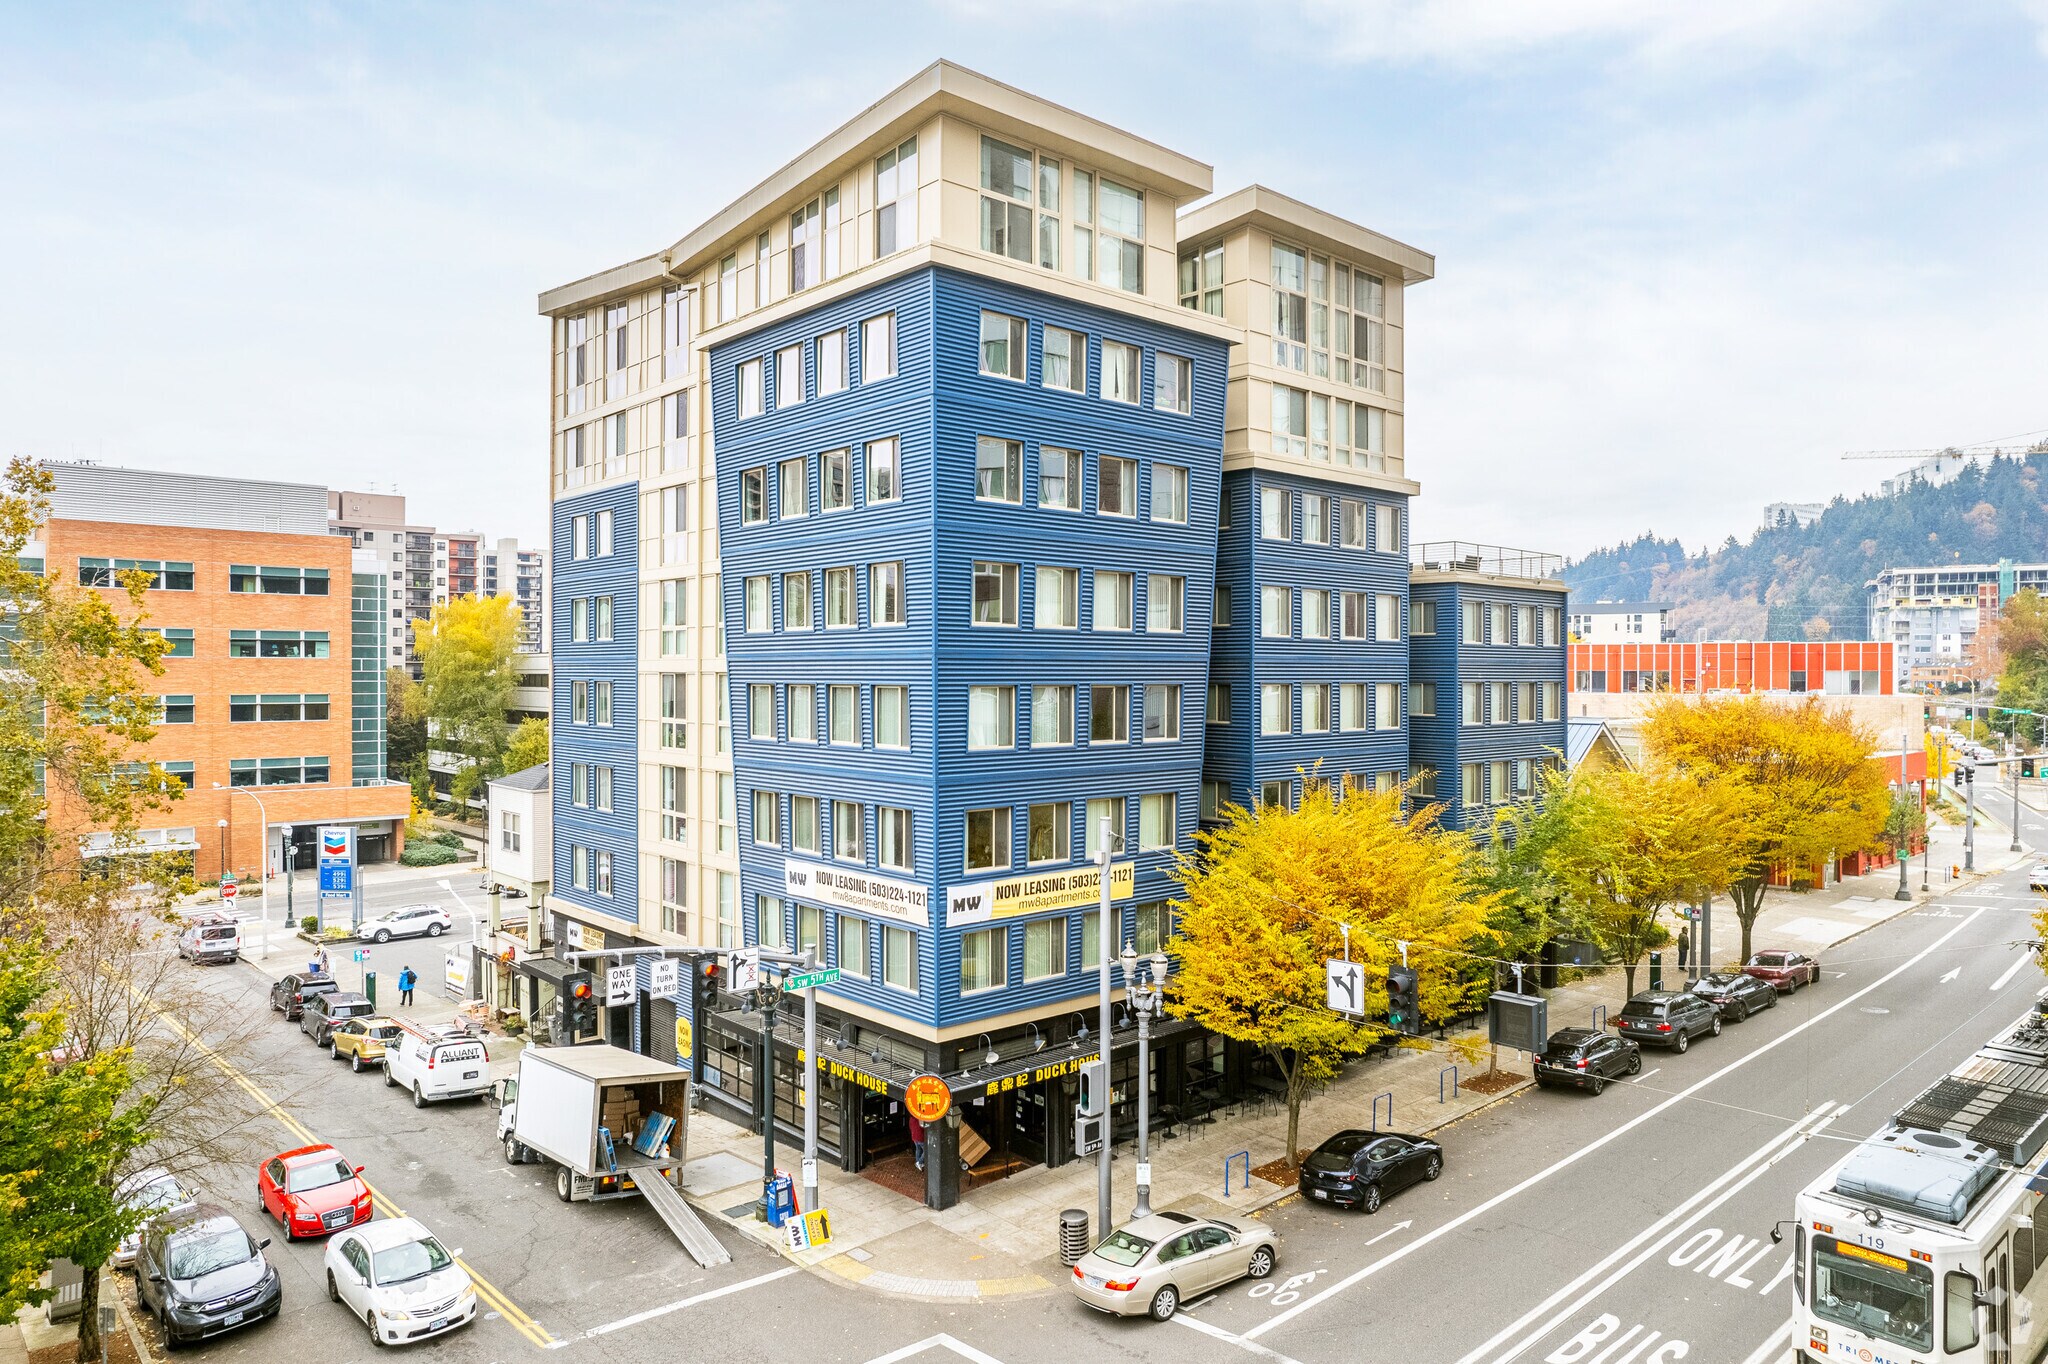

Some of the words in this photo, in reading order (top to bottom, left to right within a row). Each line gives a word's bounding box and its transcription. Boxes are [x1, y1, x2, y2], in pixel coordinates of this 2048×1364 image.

[789, 870, 807, 886] MW
[816, 870, 834, 887] NOW
[835, 874, 867, 894] LEASING
[868, 881, 926, 907] (503)224-1121
[996, 883, 1021, 900] NOW
[1024, 879, 1066, 896] LEASING
[1069, 868, 1132, 891] (503)2-1121
[832, 890, 908, 916] mw8apartments.com
[953, 895, 982, 913] MW
[1018, 888, 1101, 910] mw8apartments.c
[612, 969, 632, 980] ONE
[656, 974, 673, 983] TURN
[798, 978, 808, 988] SW
[810, 974, 824, 986] 5TH
[826, 973, 838, 982] AVE
[612, 979, 632, 990] WAY
[652, 986, 662, 994] ON
[664, 984, 676, 993] RED
[680, 1026, 688, 1036] NOW
[441, 1048, 479, 1059] ALLIANT
[1036, 1062, 1068, 1082] DUCK
[1070, 1054, 1100, 1072] HOUS
[830, 1061, 854, 1082] DUCK
[856, 1072, 888, 1095] HOUSE
[791, 1226, 802, 1246] MW
[1858, 1233, 1884, 1250] 119
[1838, 1342, 1856, 1355] TRI
[1875, 1356, 1898, 1364] ME
